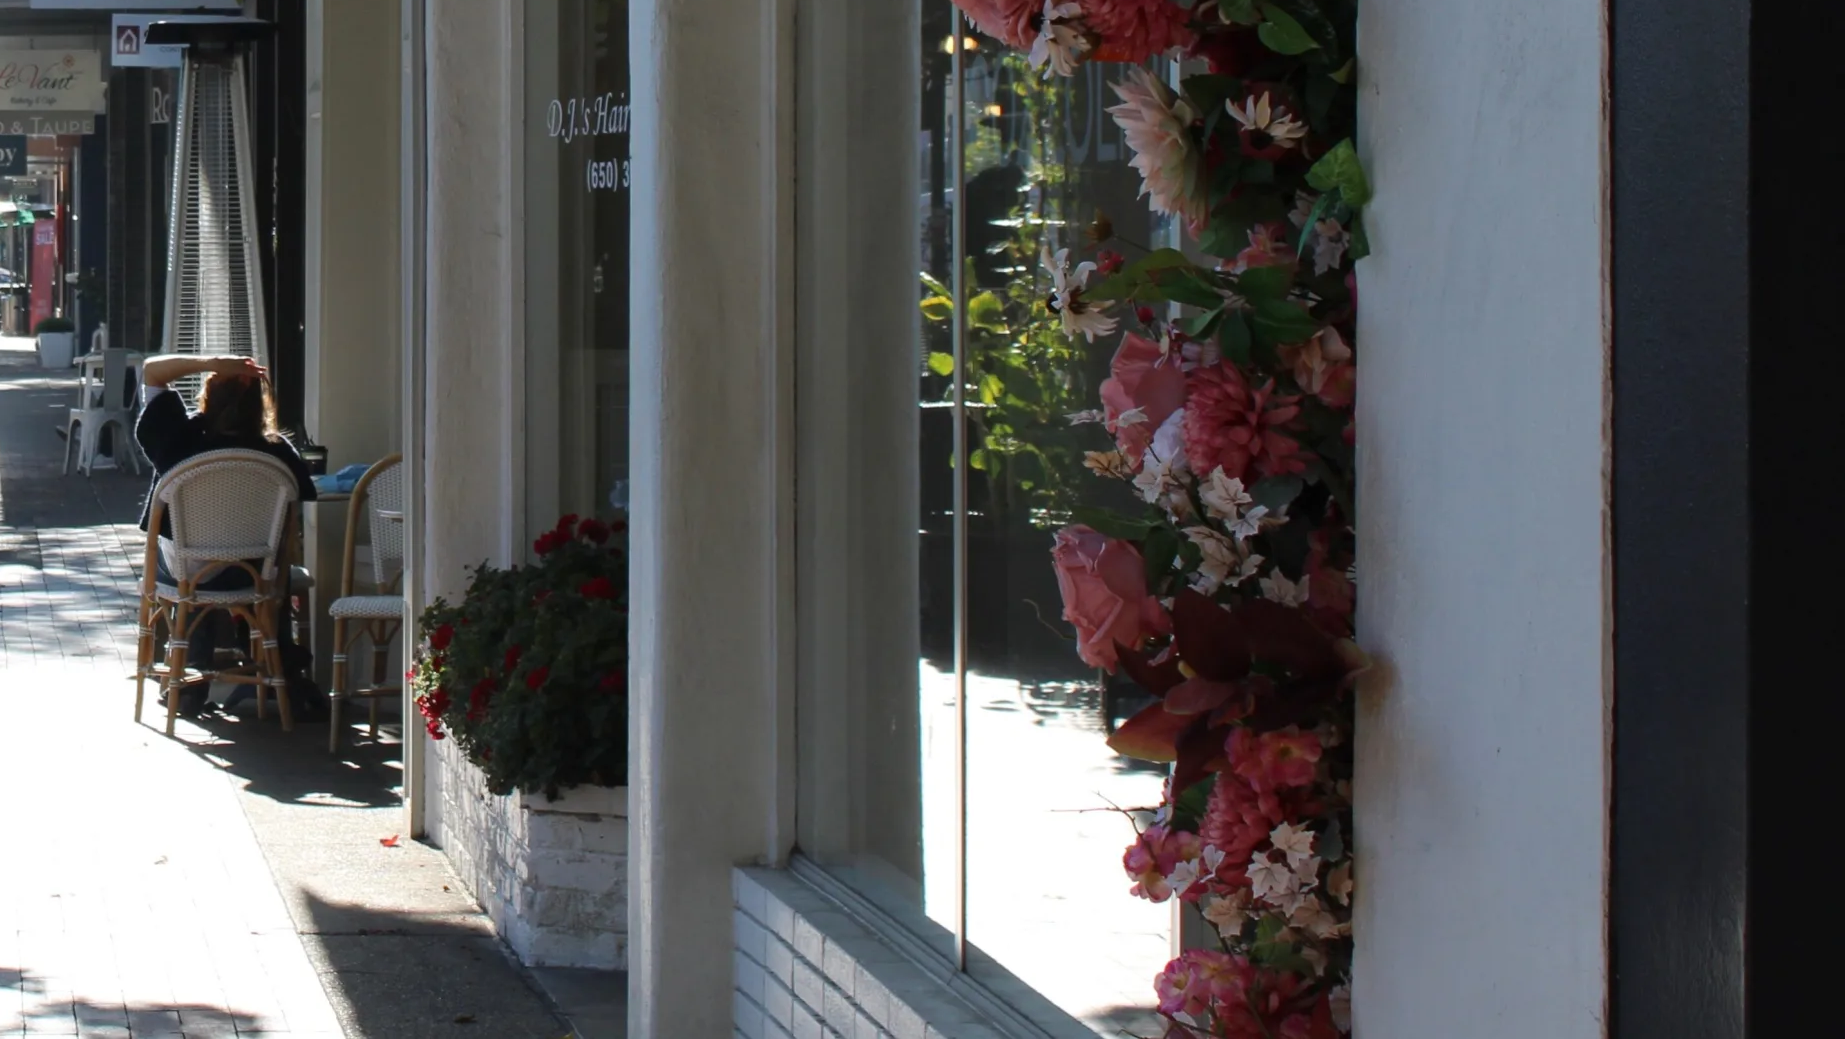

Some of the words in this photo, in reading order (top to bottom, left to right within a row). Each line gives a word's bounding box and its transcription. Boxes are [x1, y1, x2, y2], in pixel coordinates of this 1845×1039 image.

[10, 121, 24, 135] &
[29, 117, 94, 135] TAUPE
[546, 98, 591, 144] D.J.'s
[592, 91, 632, 136] Hair
[587, 157, 619, 193] (650)
